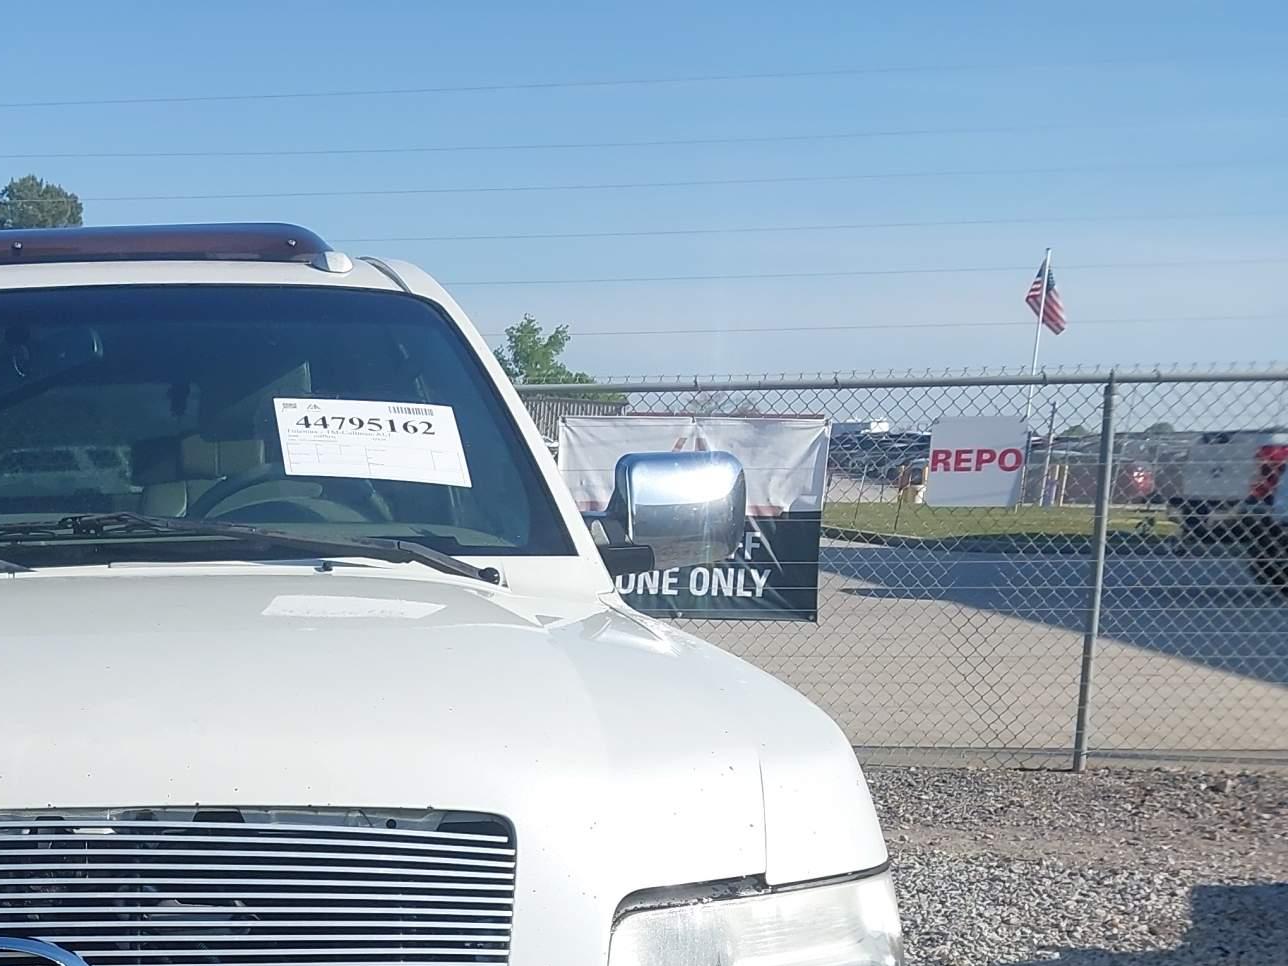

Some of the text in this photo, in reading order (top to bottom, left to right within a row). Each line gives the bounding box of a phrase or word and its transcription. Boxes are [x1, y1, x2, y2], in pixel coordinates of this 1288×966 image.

[295, 415, 436, 436] 44795162
[930, 448, 1023, 472] REPO
[689, 567, 771, 598] ONLY
